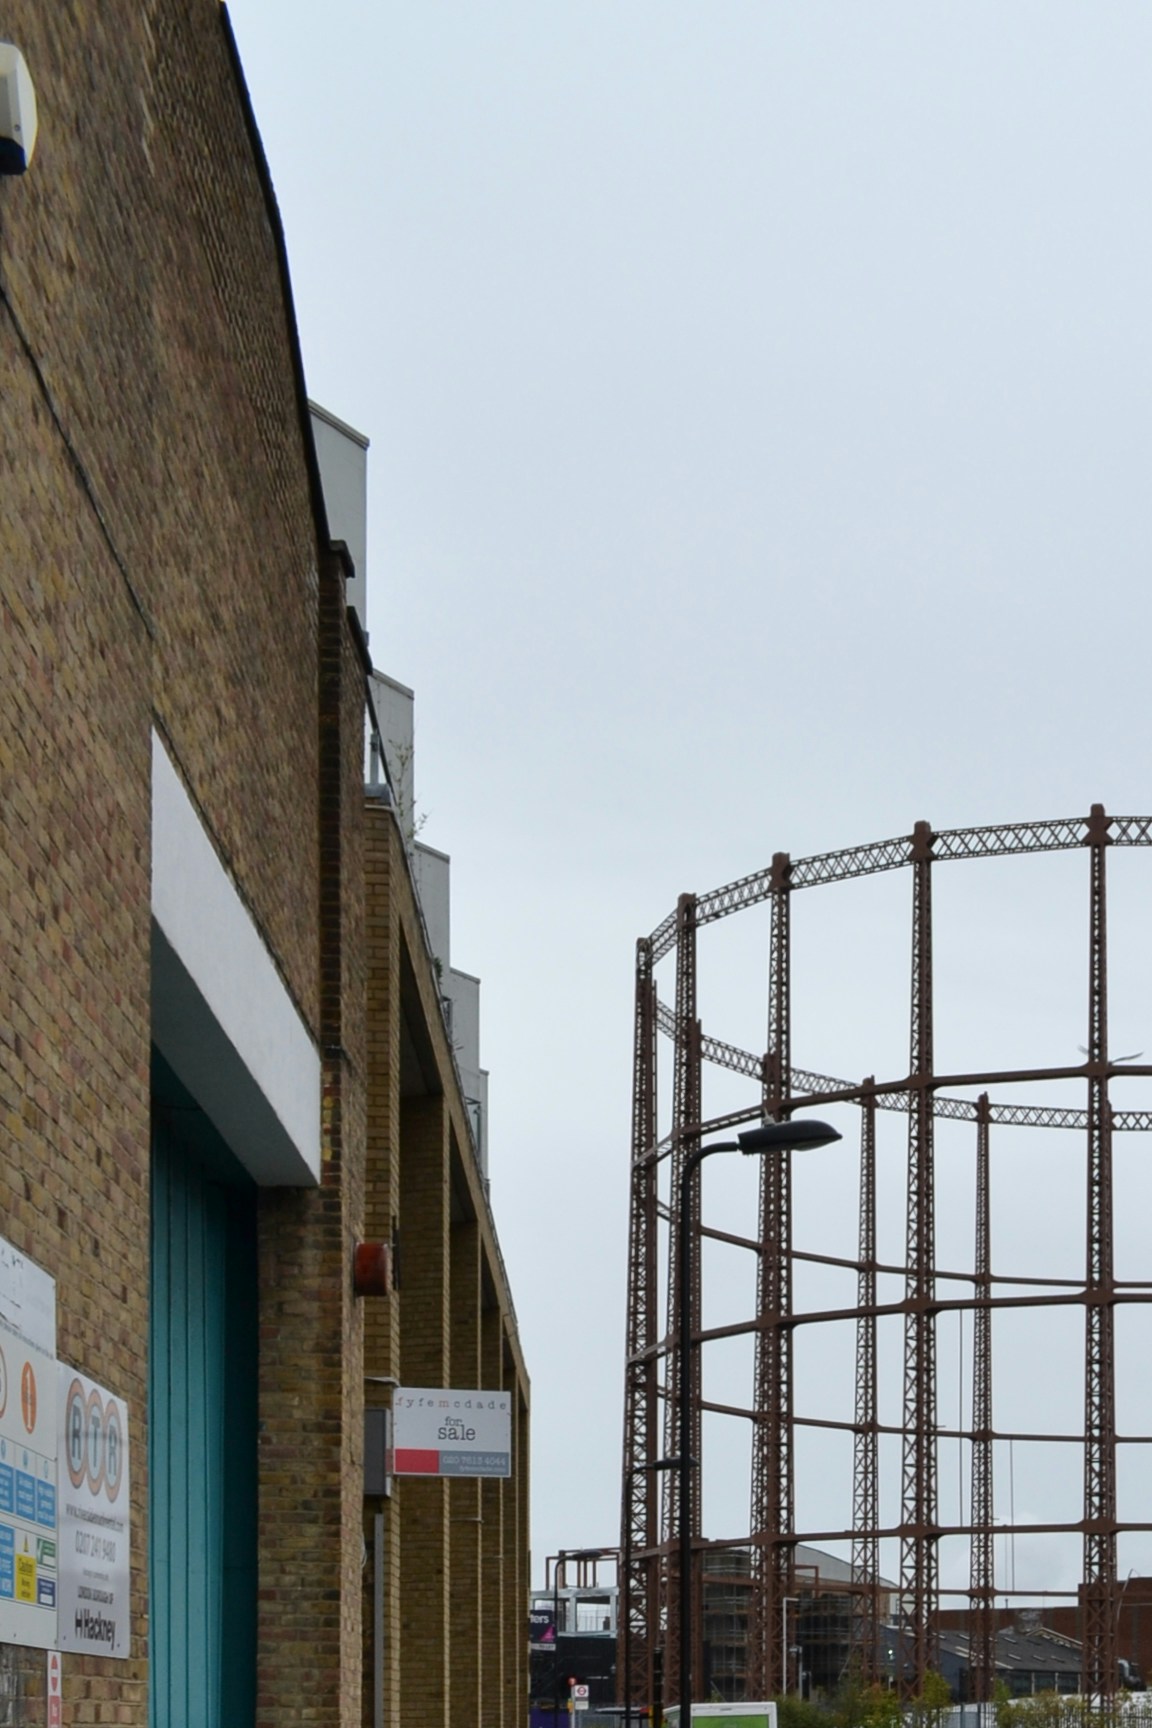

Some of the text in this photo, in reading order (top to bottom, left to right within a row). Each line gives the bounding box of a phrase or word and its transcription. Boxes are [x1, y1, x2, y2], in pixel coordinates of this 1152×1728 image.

[395, 1397, 507, 1410] fyfemcdade
[445, 1416, 462, 1427] for
[72, 1404, 117, 1476] RTR
[437, 1424, 476, 1441] sale
[443, 1455, 459, 1464] 020
[83, 1607, 116, 1651] Hackney
